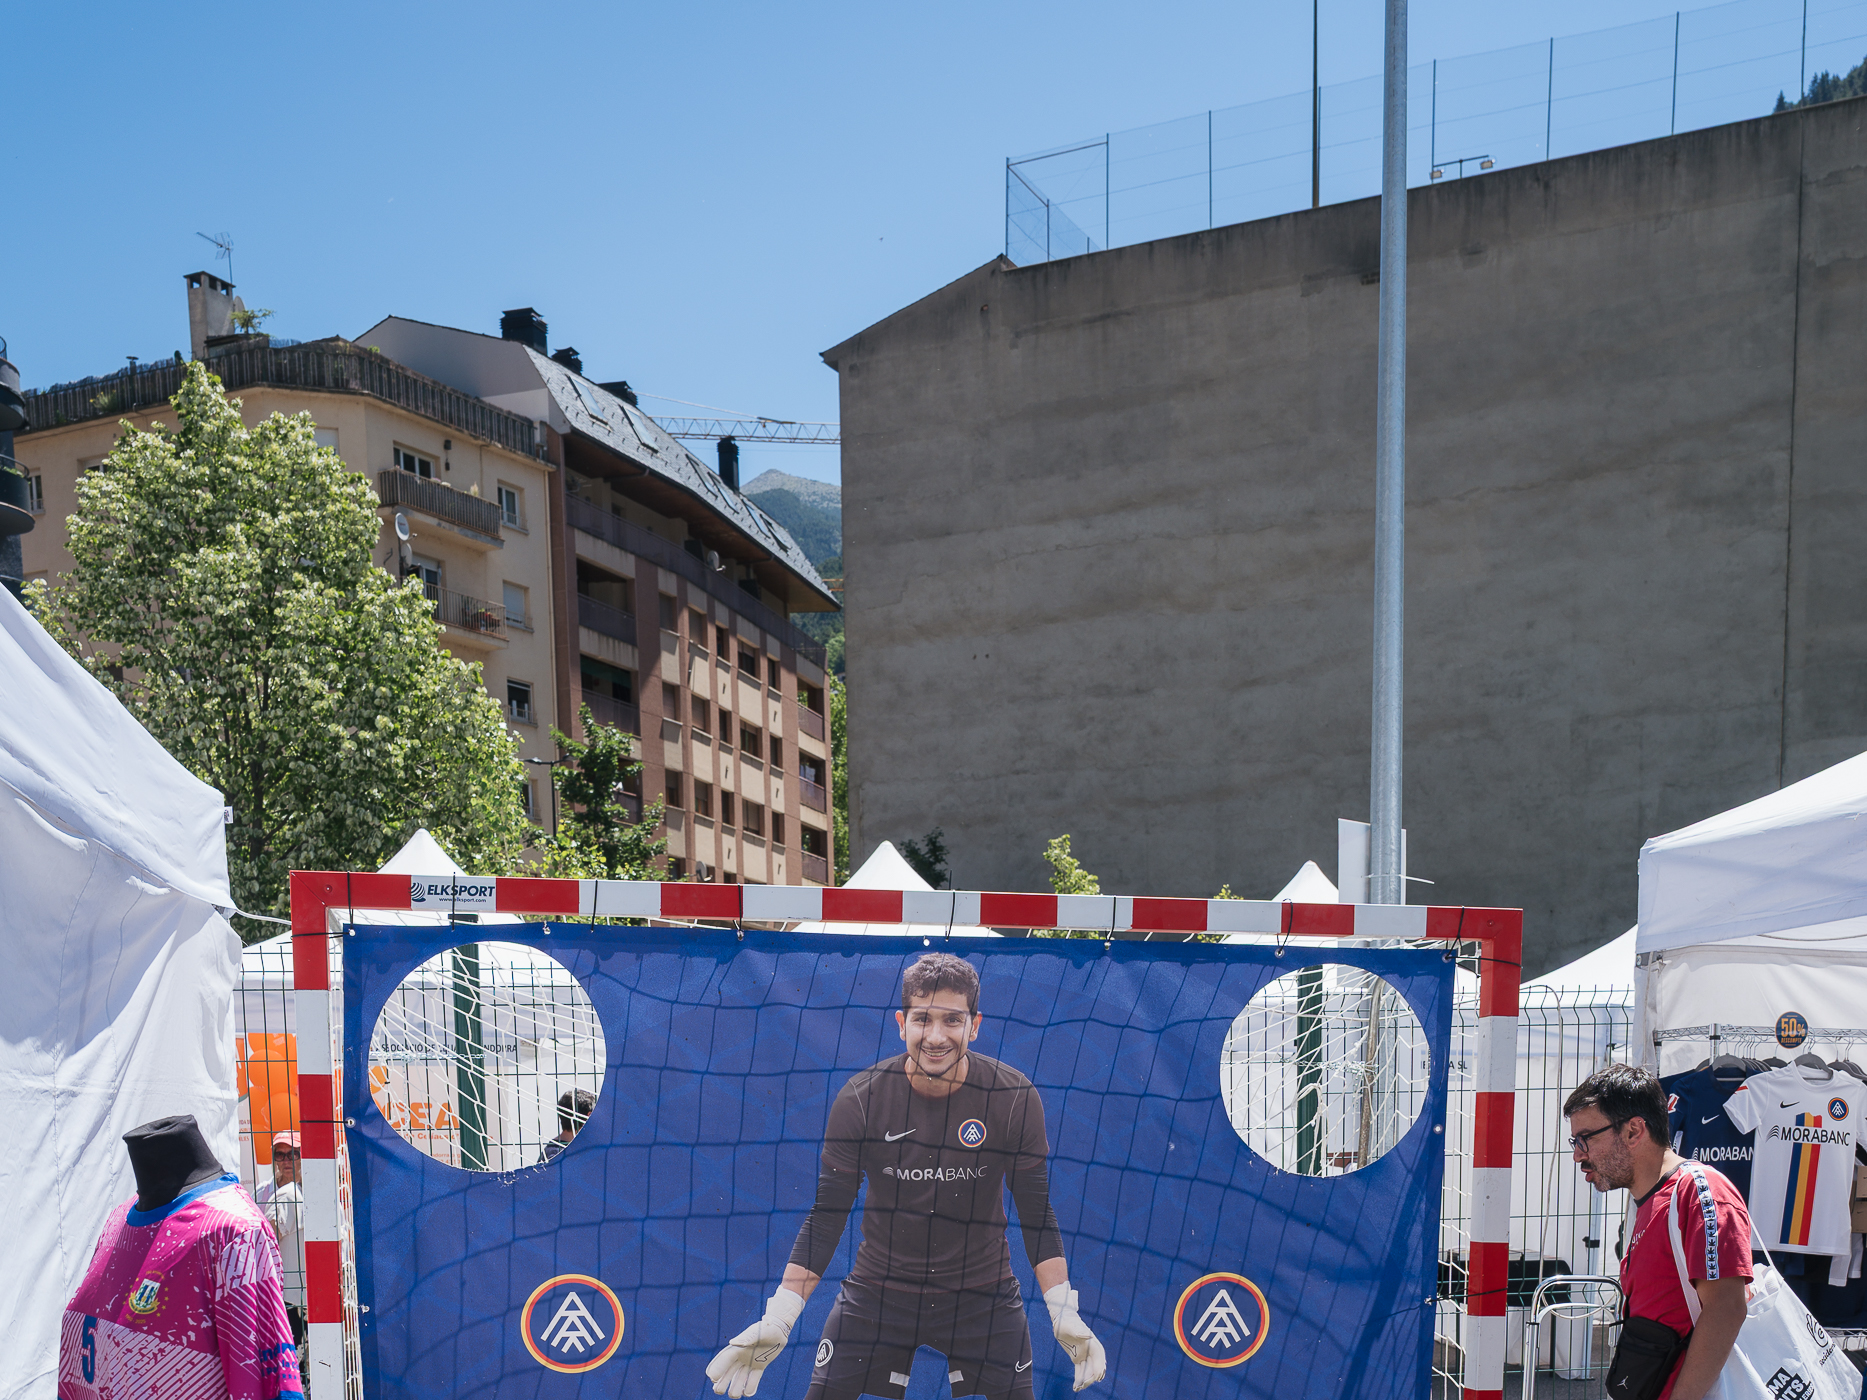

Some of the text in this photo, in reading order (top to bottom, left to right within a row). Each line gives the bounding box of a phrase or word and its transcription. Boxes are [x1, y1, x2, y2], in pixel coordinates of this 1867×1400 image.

[427, 884, 496, 897] ELKSPORT
[1781, 1017, 1806, 1038] 50%
[484, 1044, 518, 1053] NDORRA
[1780, 1125, 1851, 1147] MORABANC
[1700, 1146, 1755, 1163] MORABAN
[897, 1165, 988, 1181] MORABANC
[82, 1314, 98, 1385] 5
